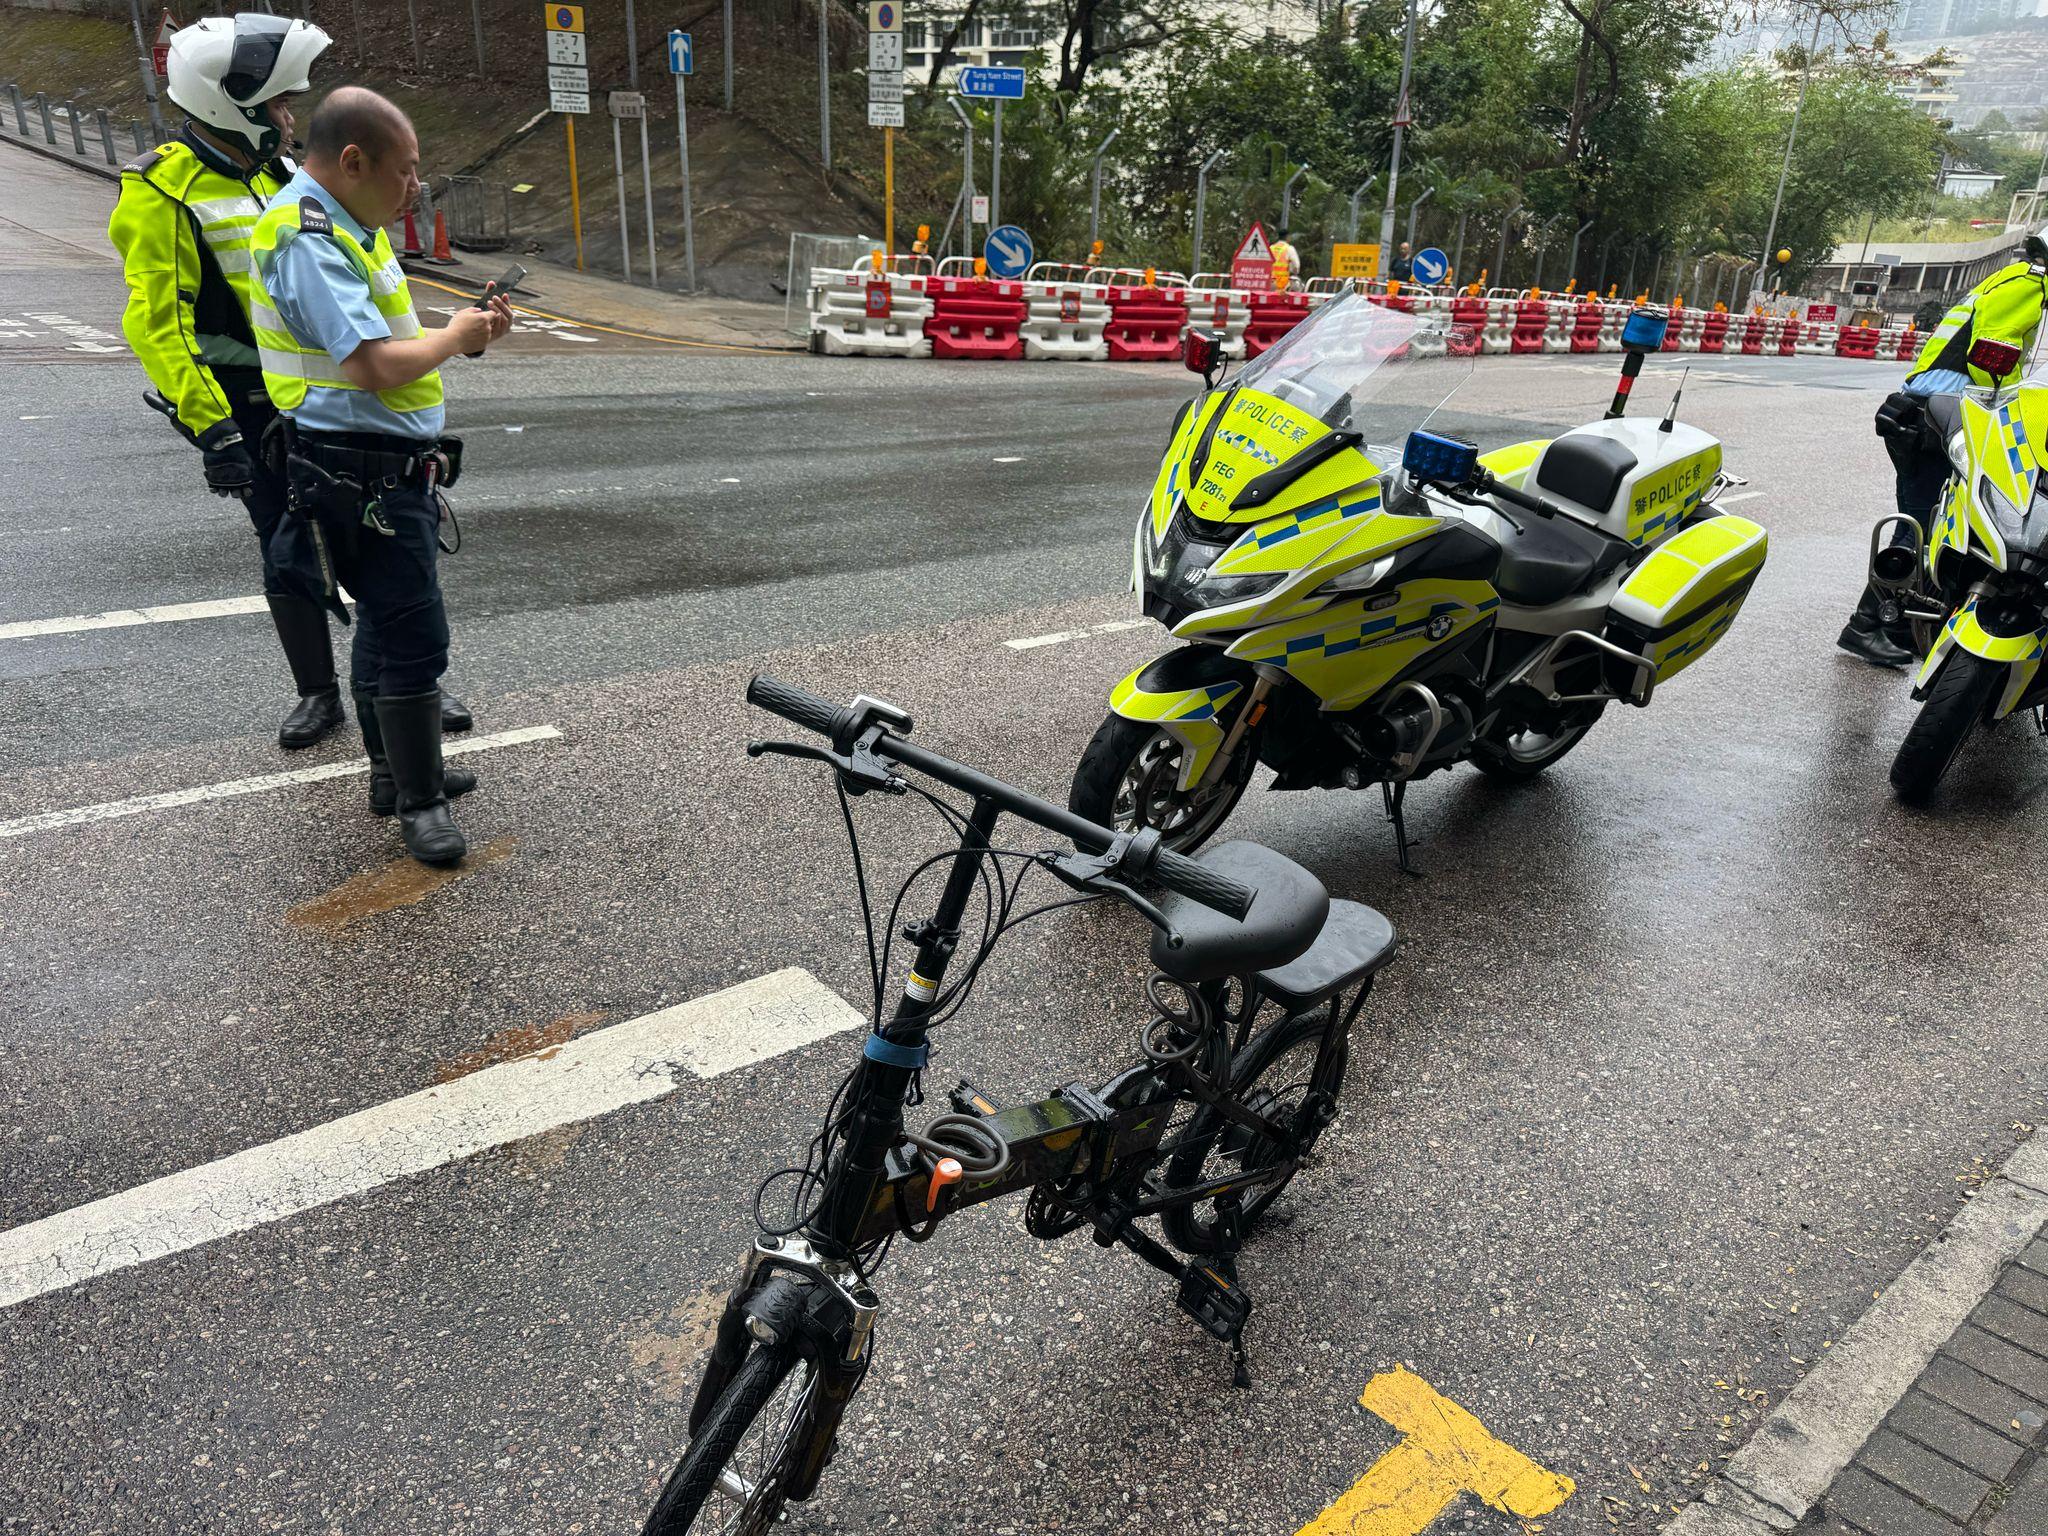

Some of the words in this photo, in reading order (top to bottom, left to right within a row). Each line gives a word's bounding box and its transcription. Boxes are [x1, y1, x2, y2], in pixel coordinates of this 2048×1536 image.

[571, 35, 578, 46] 7
[890, 35, 897, 48] 7
[572, 52, 579, 63] 7
[890, 56, 897, 68] 7
[1002, 72, 1022, 80] Street
[1242, 402, 1295, 436] POLICE
[1288, 426, 1309, 444] 察
[1212, 461, 1235, 479] FEG
[1200, 479, 1223, 498] 7281
[1649, 469, 1692, 509] POLICE
[1200, 501, 1208, 511] E
